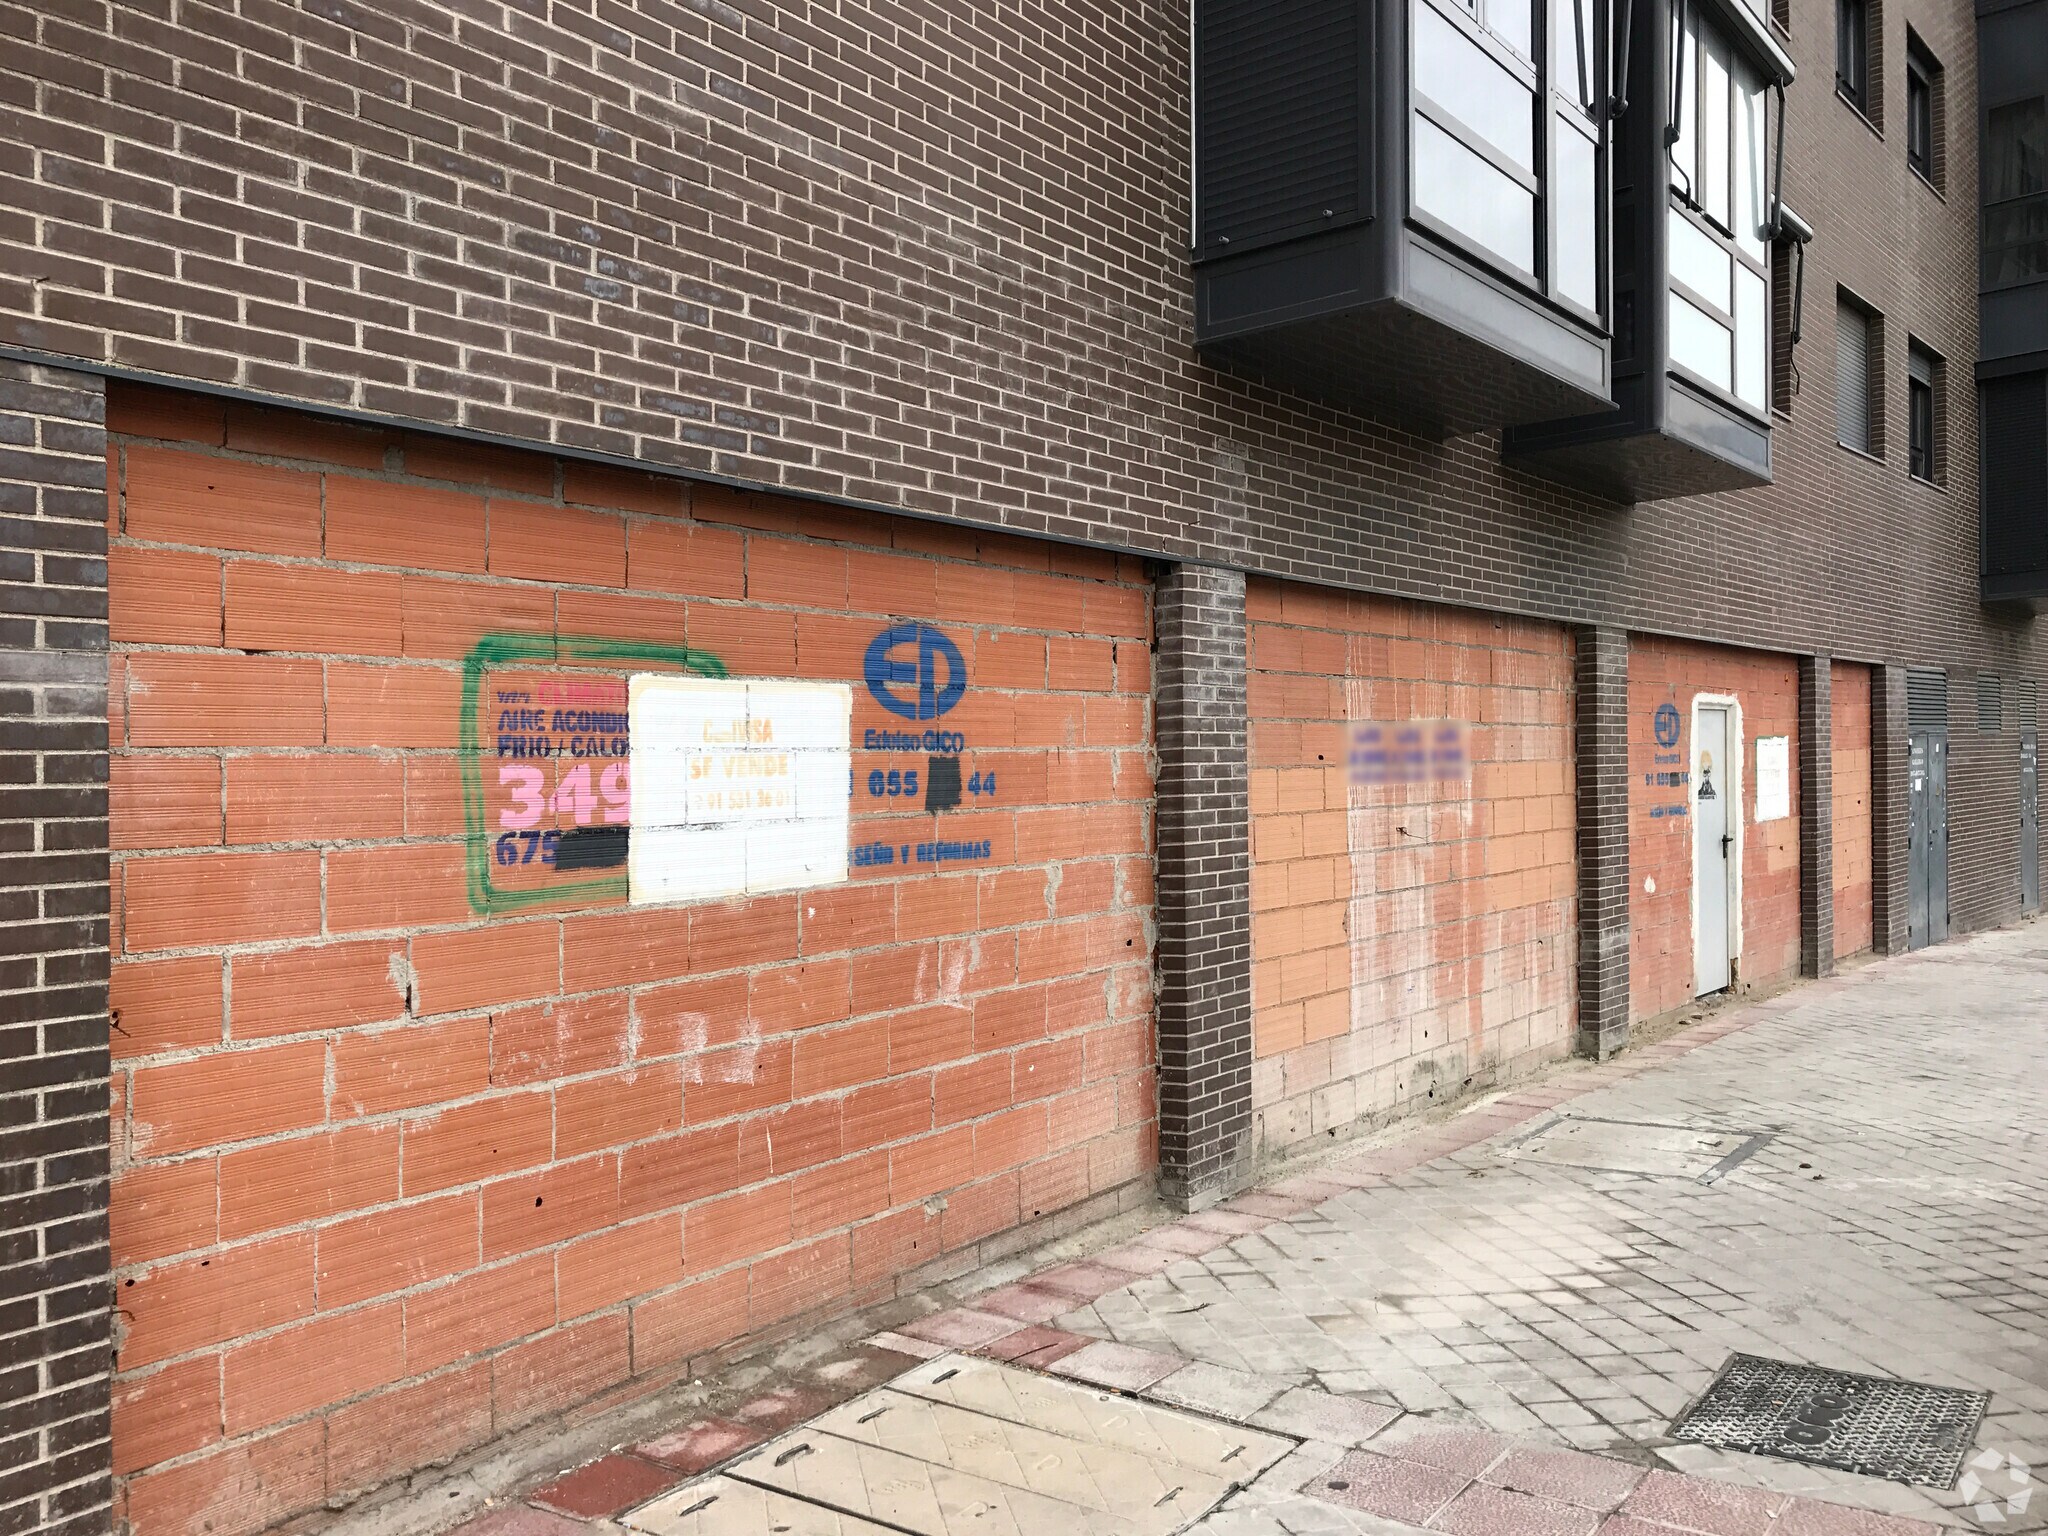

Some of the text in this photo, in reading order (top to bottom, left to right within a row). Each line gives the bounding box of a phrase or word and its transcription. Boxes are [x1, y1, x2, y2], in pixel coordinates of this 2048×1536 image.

[497, 709, 545, 732] AIRE
[497, 735, 551, 758] FRIO
[868, 769, 918, 797] 655
[968, 771, 996, 796] 44
